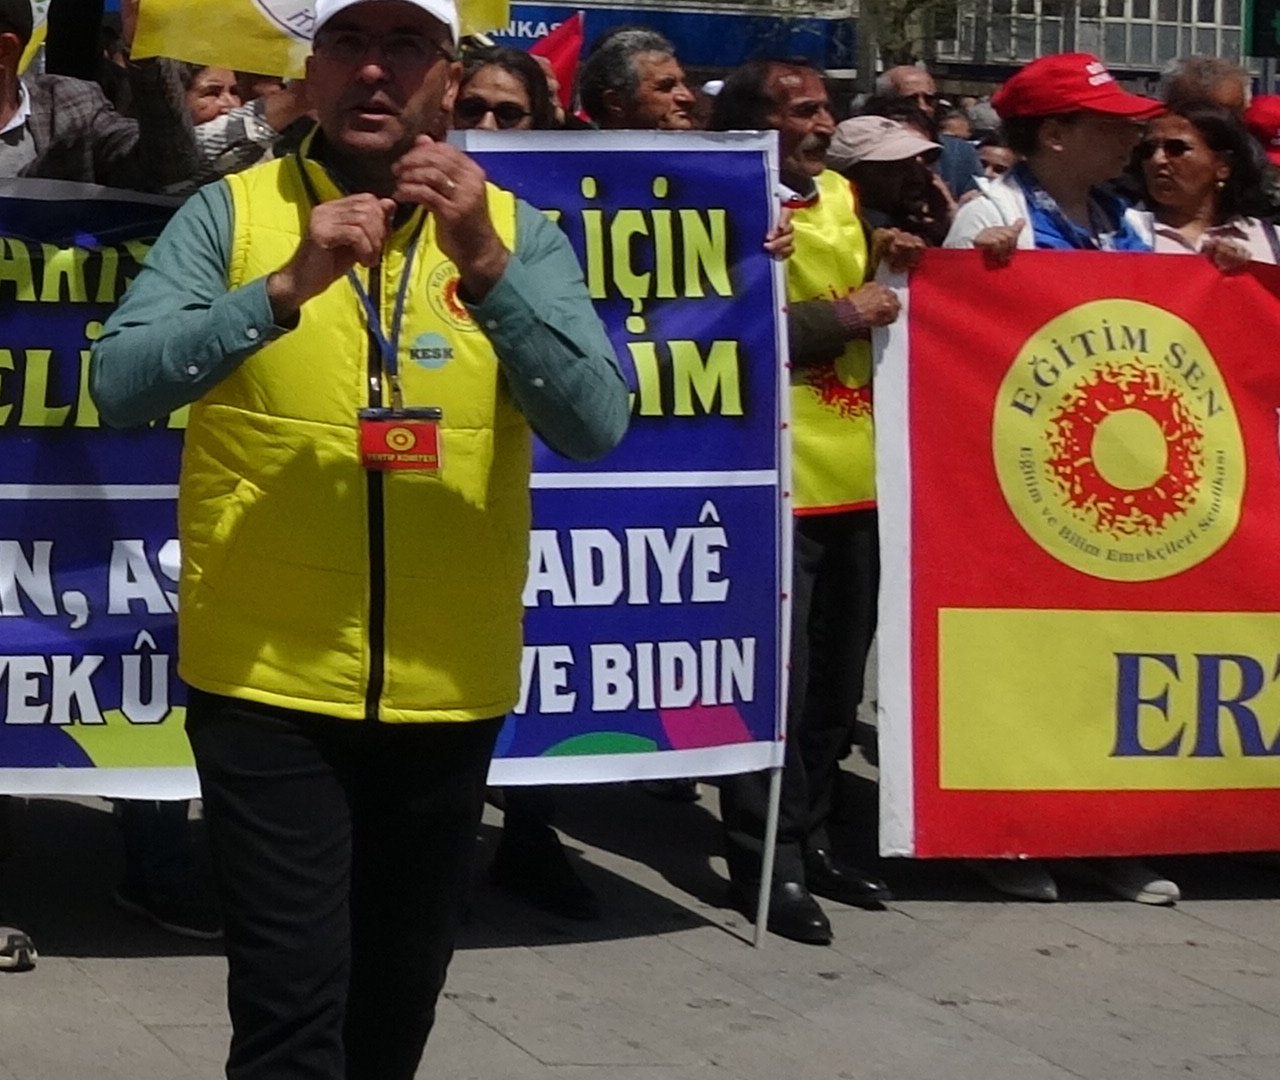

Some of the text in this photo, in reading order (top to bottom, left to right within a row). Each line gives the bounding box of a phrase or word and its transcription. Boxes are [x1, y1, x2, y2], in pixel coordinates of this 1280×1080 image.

[582, 176, 734, 316] İÇİN
[410, 347, 454, 360] KESK
[1010, 319, 1224, 418] EĞİTİM SEN
[590, 636, 756, 713] BIDIN
[1109, 652, 1280, 760] ER
